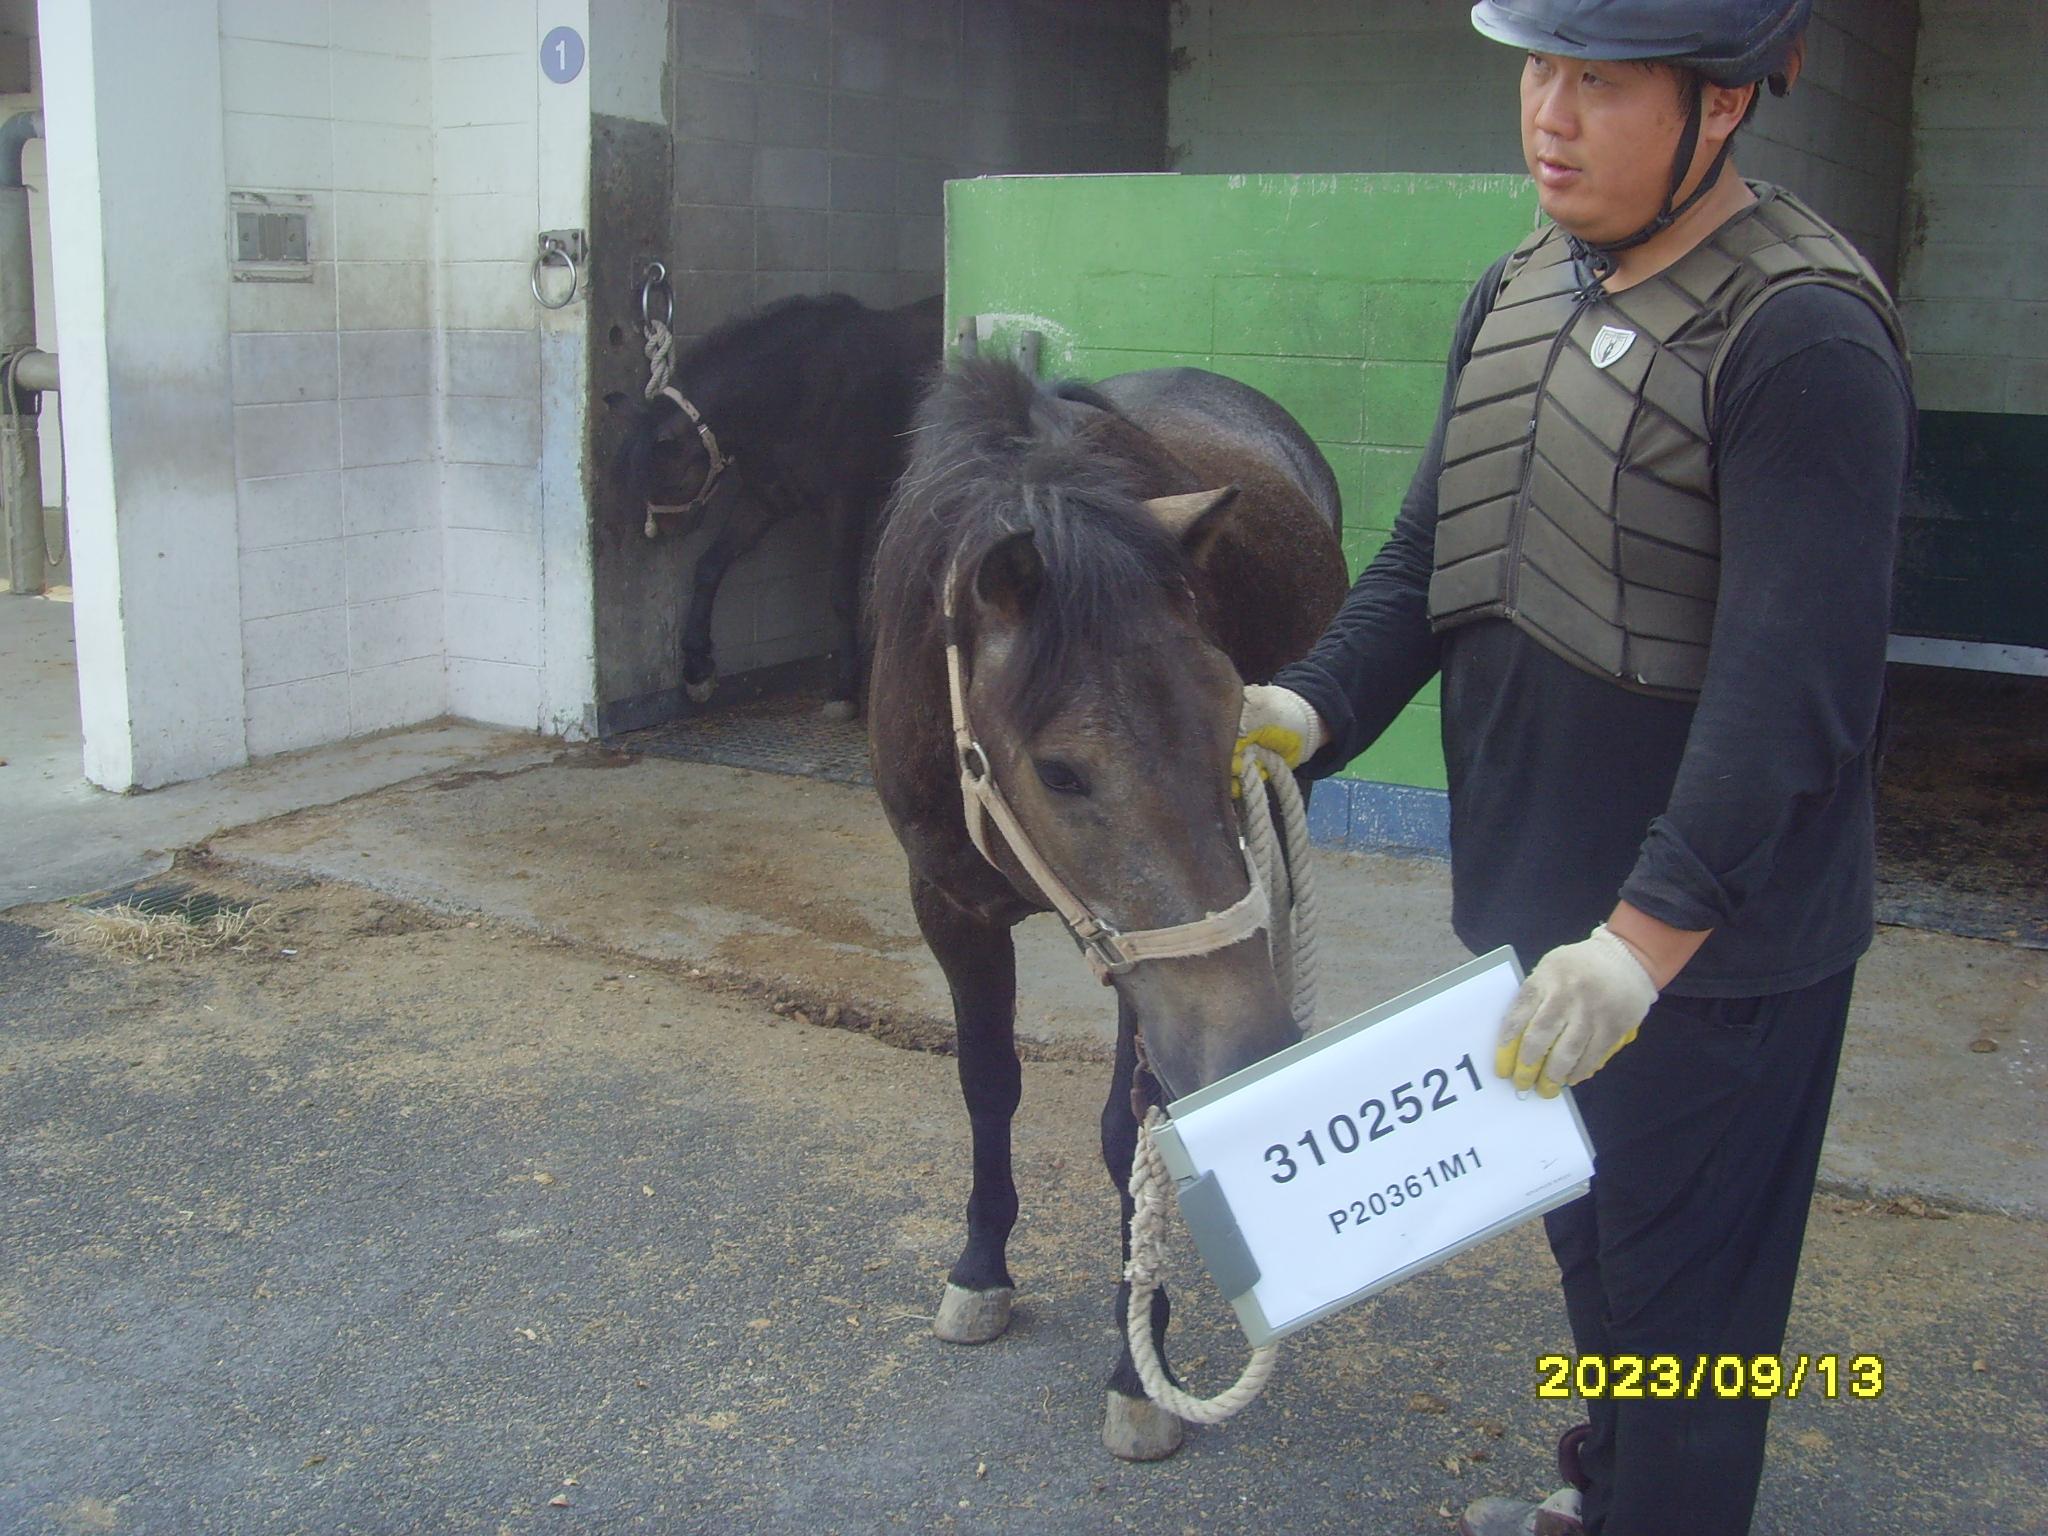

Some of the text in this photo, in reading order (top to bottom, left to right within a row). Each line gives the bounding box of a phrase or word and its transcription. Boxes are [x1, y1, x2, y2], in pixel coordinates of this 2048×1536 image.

[555, 40, 566, 71] 1
[1263, 1053, 1484, 1184] 3102521
[1328, 1146, 1483, 1235] P20361M1
